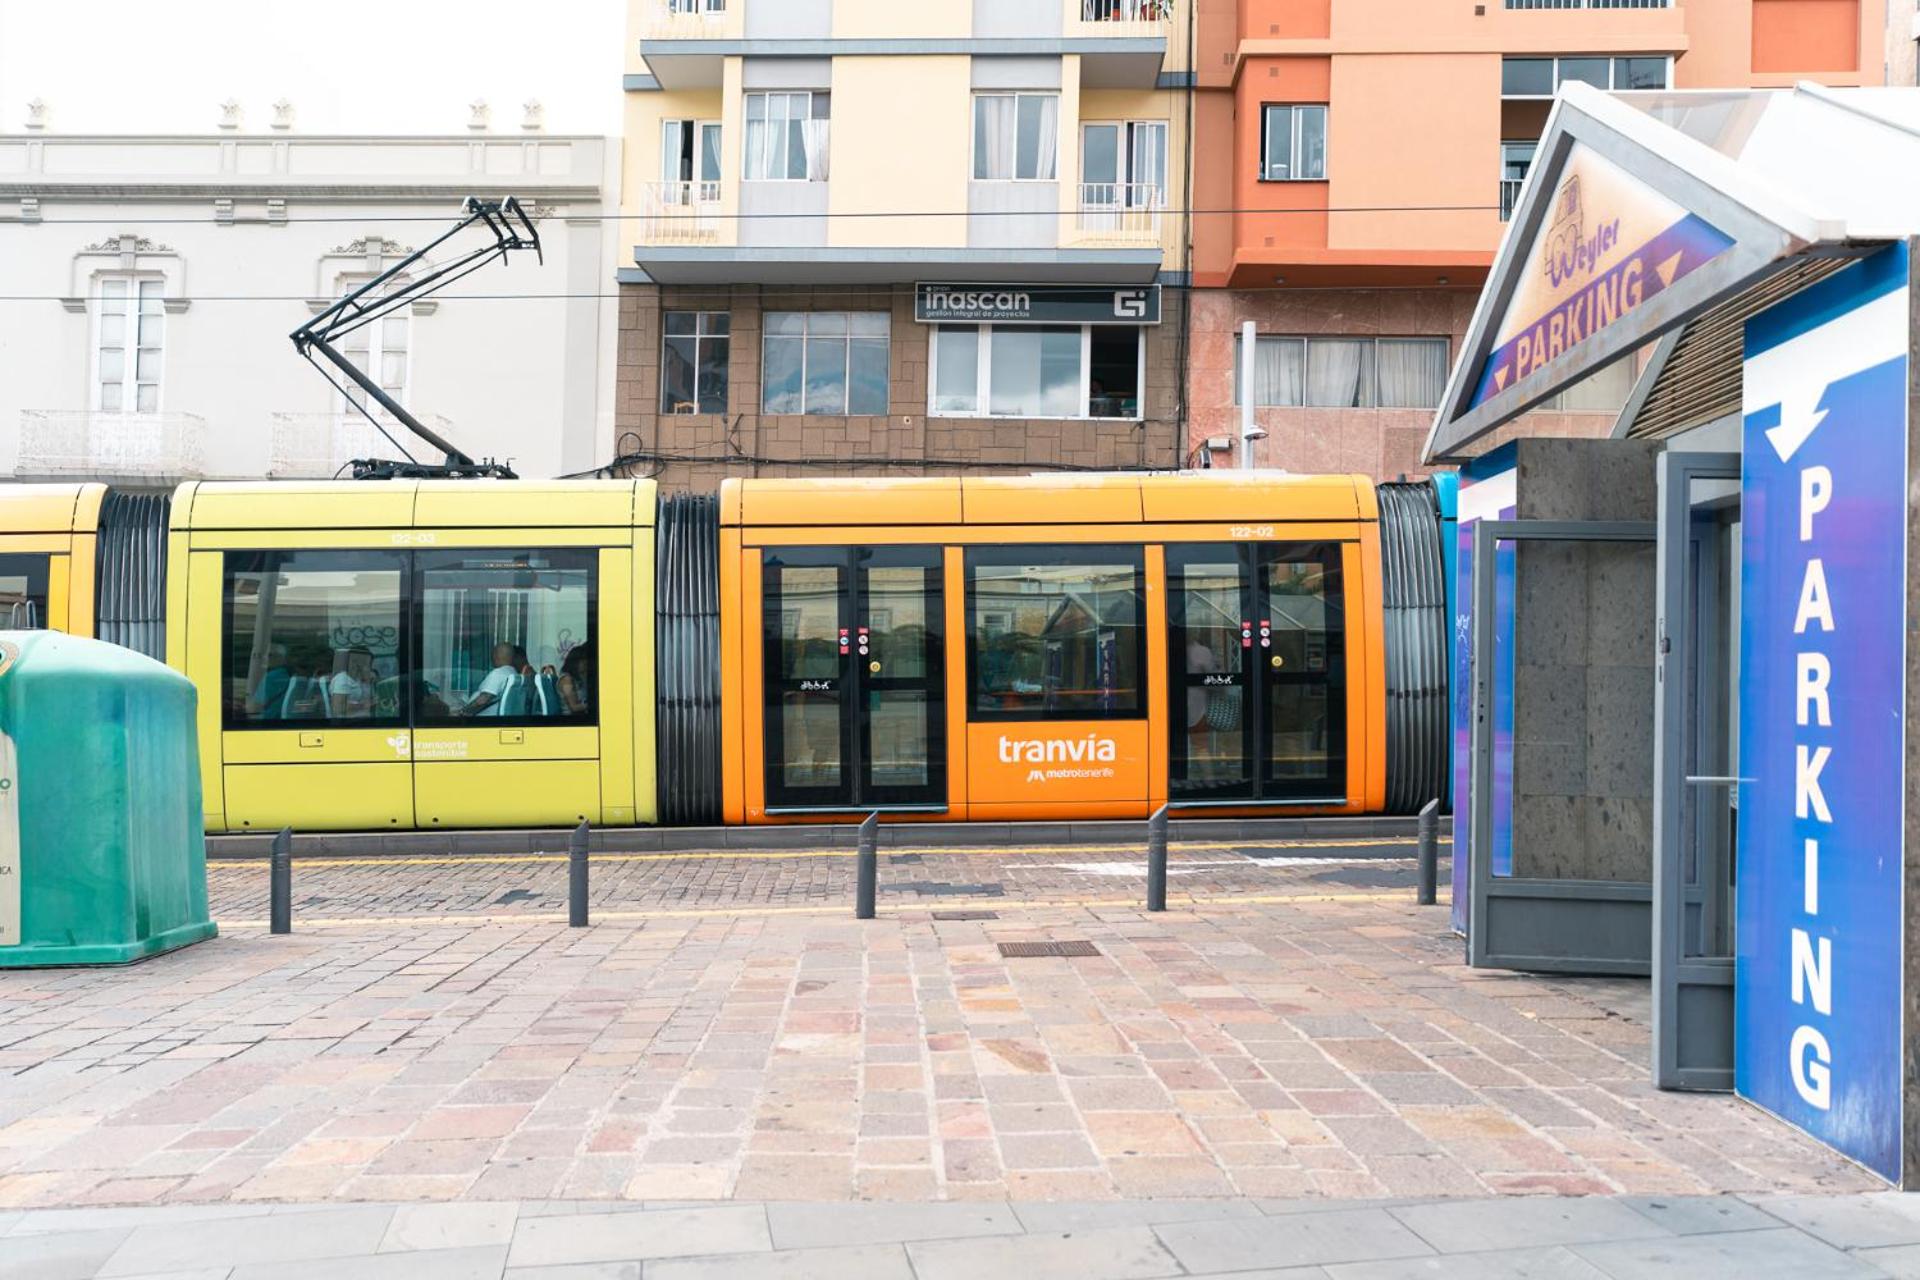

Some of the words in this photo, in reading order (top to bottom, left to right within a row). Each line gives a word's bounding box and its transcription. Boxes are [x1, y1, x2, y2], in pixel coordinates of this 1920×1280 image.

[1551, 218, 1620, 288] Weyler
[926, 286, 1030, 310] inascan
[982, 309, 992, 317] de
[1516, 257, 1643, 384] PARKING
[1230, 526, 1273, 538] 122-02
[998, 733, 1116, 763] tranvía
[1046, 767, 1114, 778] metrotenerife
[1790, 465, 1832, 1112] PARKING
